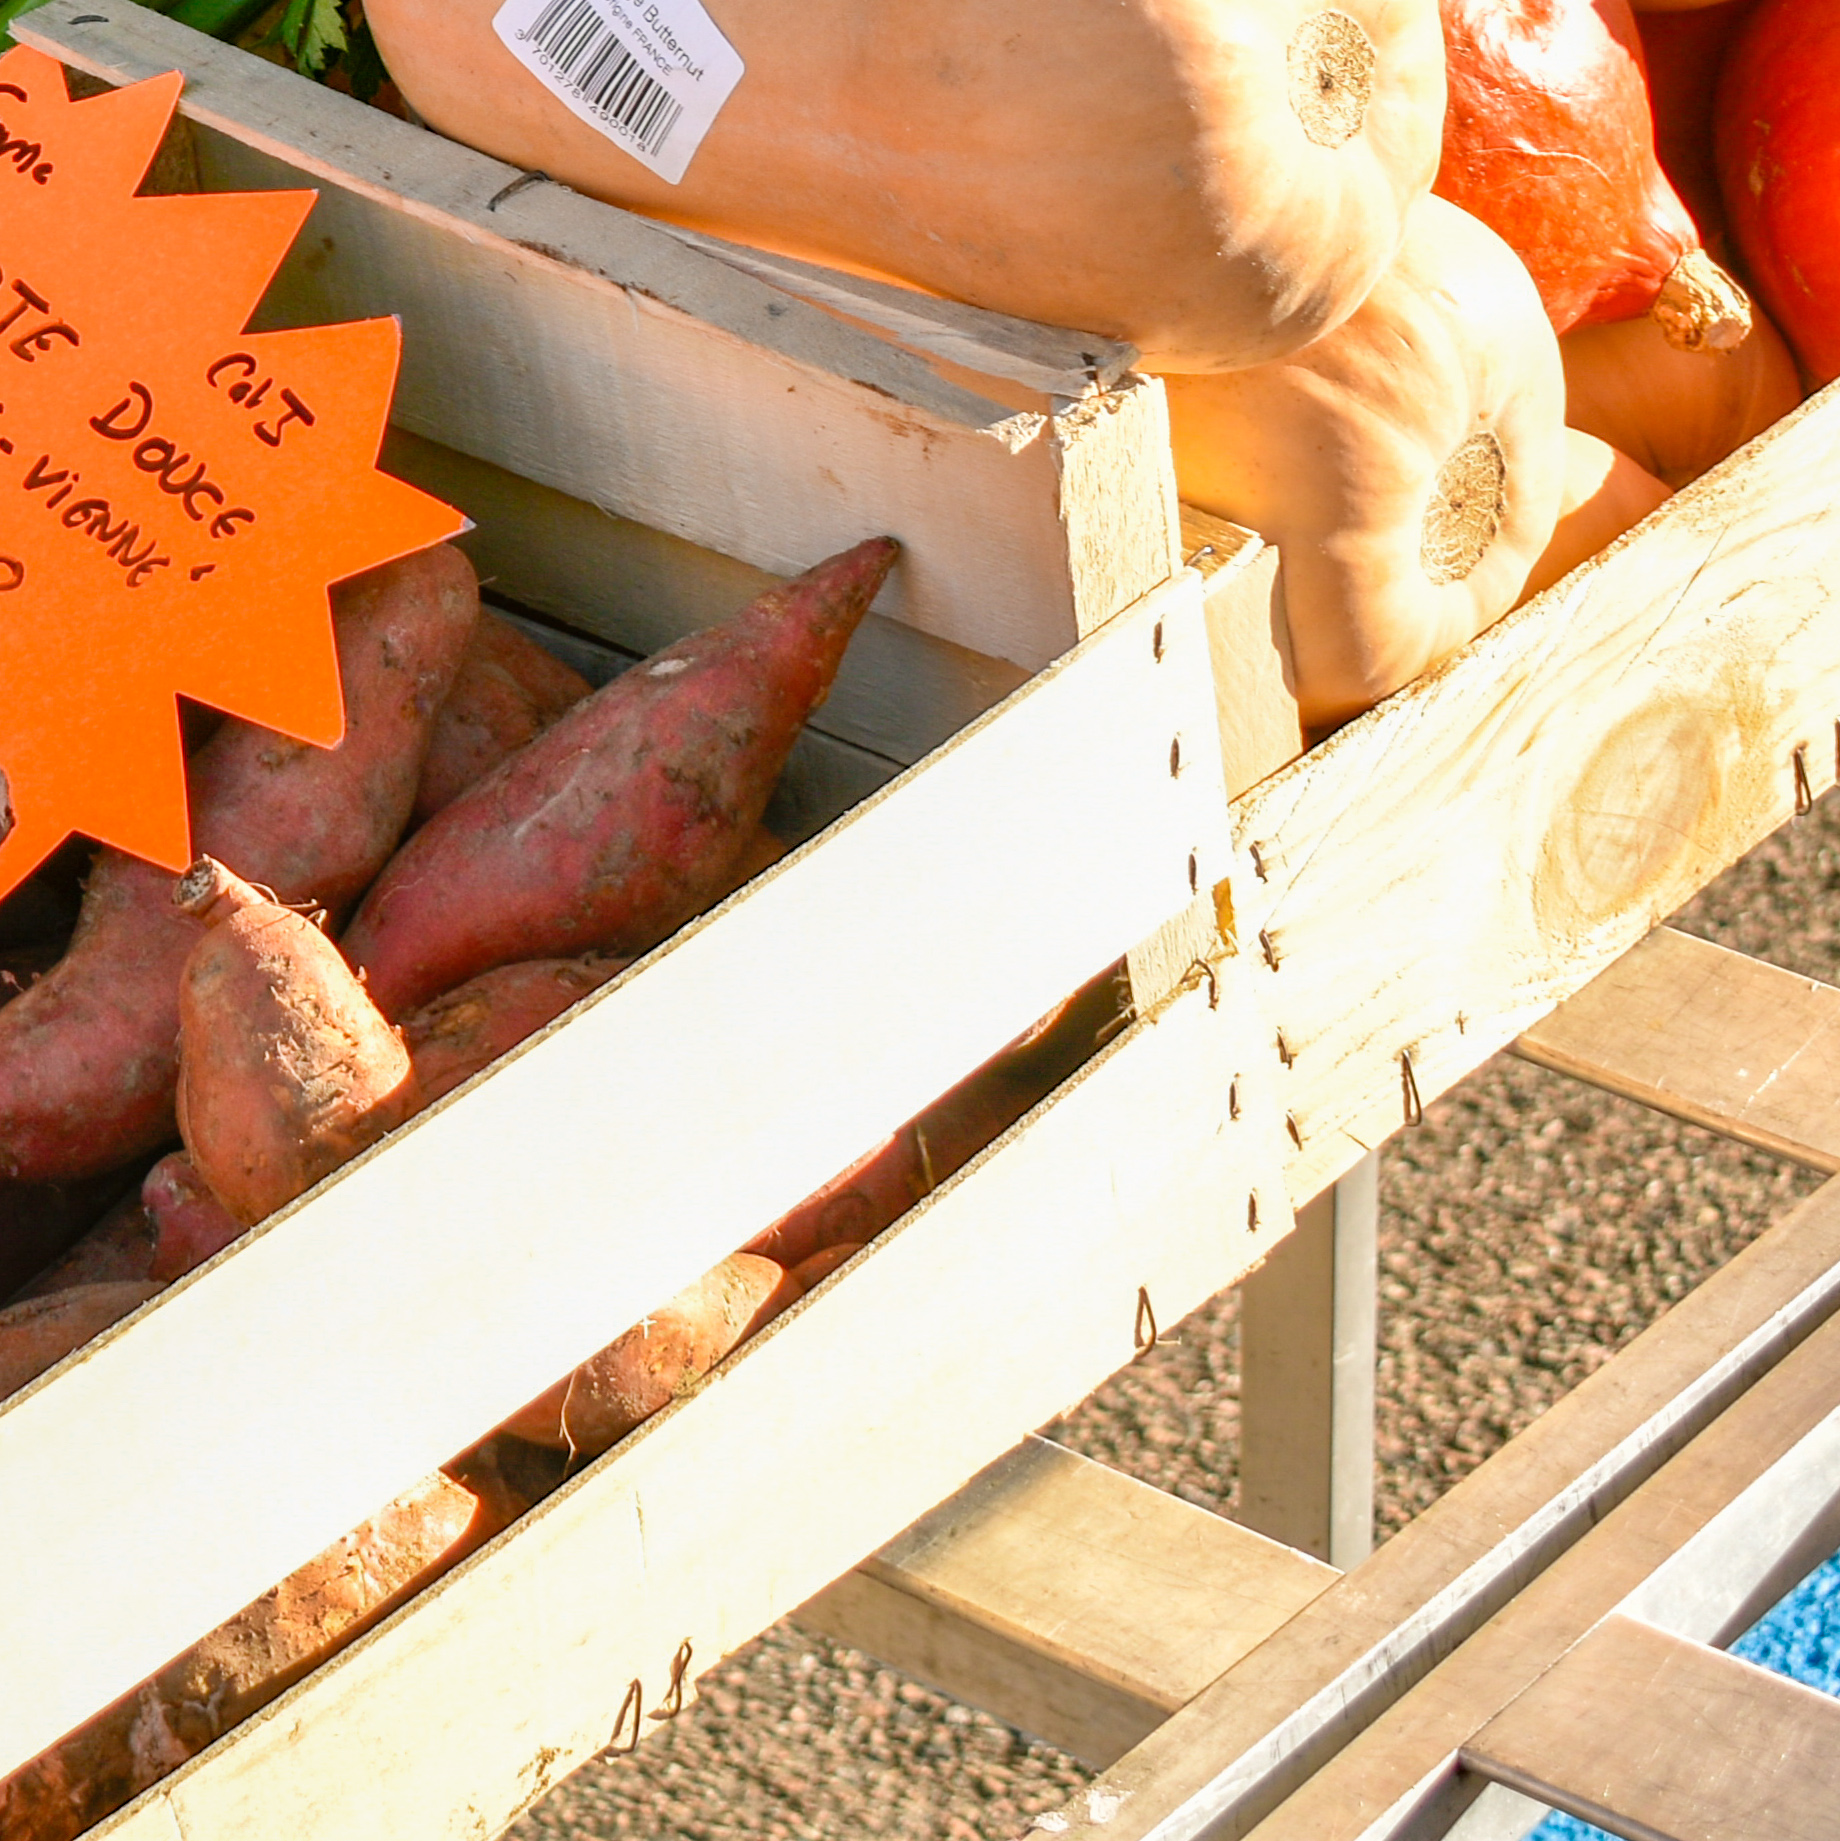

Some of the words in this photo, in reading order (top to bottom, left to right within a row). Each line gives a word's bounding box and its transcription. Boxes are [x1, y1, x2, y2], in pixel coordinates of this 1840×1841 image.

[631, 27, 674, 77] FRANCE
[642, 4, 705, 82] Butternut
[89, 381, 257, 542] DOUCE
